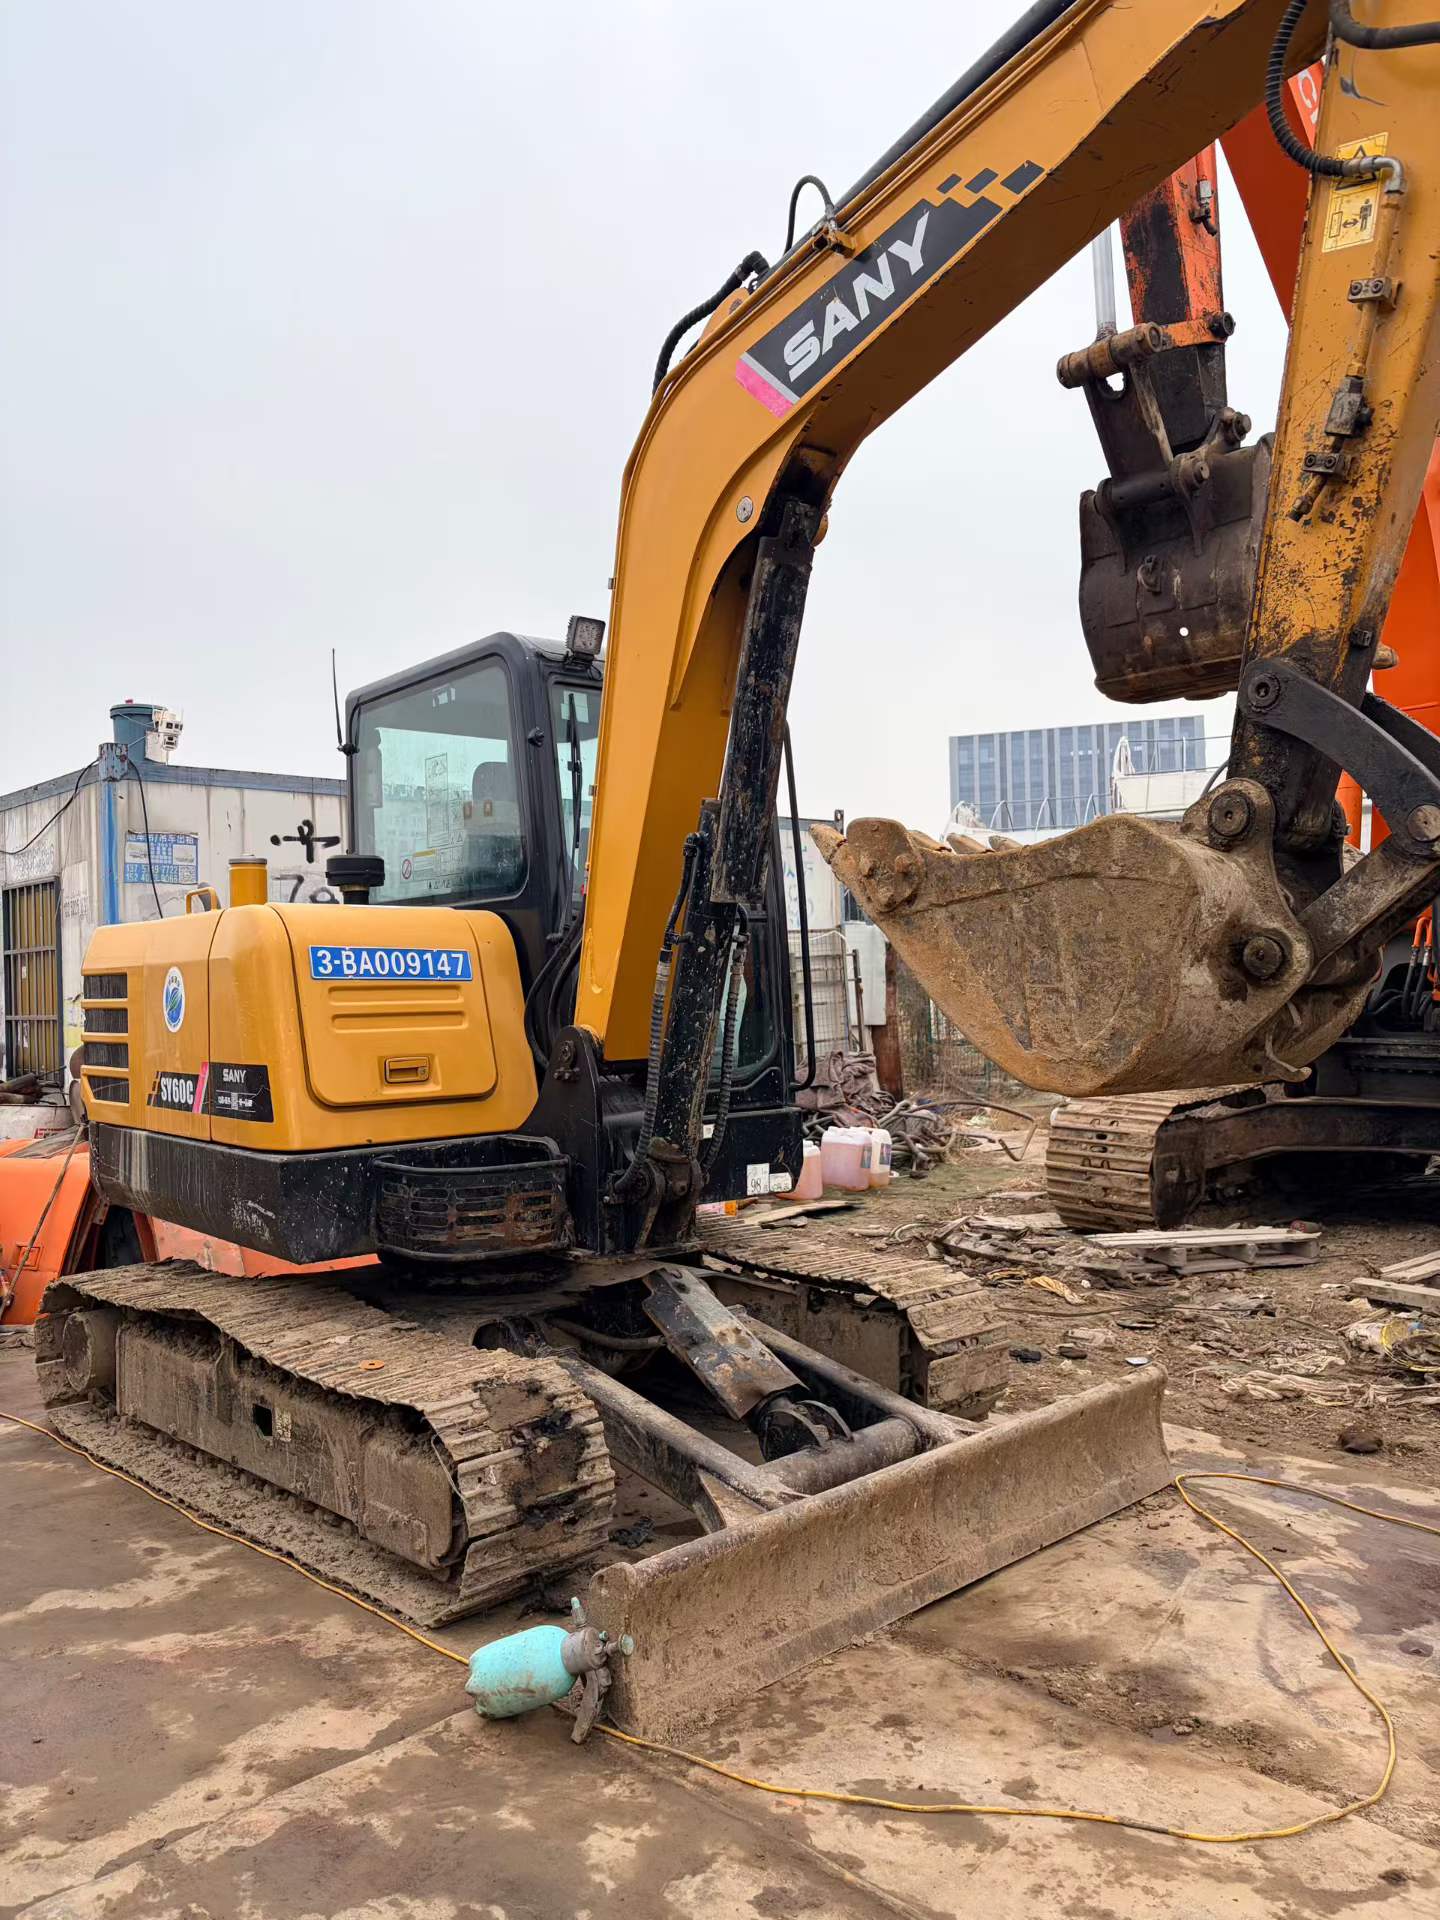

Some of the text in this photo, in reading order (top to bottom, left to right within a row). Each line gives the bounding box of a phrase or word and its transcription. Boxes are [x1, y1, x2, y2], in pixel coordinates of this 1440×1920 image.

[784, 210, 930, 383] SANY
[316, 949, 464, 976] 3-BA009147
[222, 1068, 247, 1083] SANY
[160, 1077, 194, 1105] SY60C
